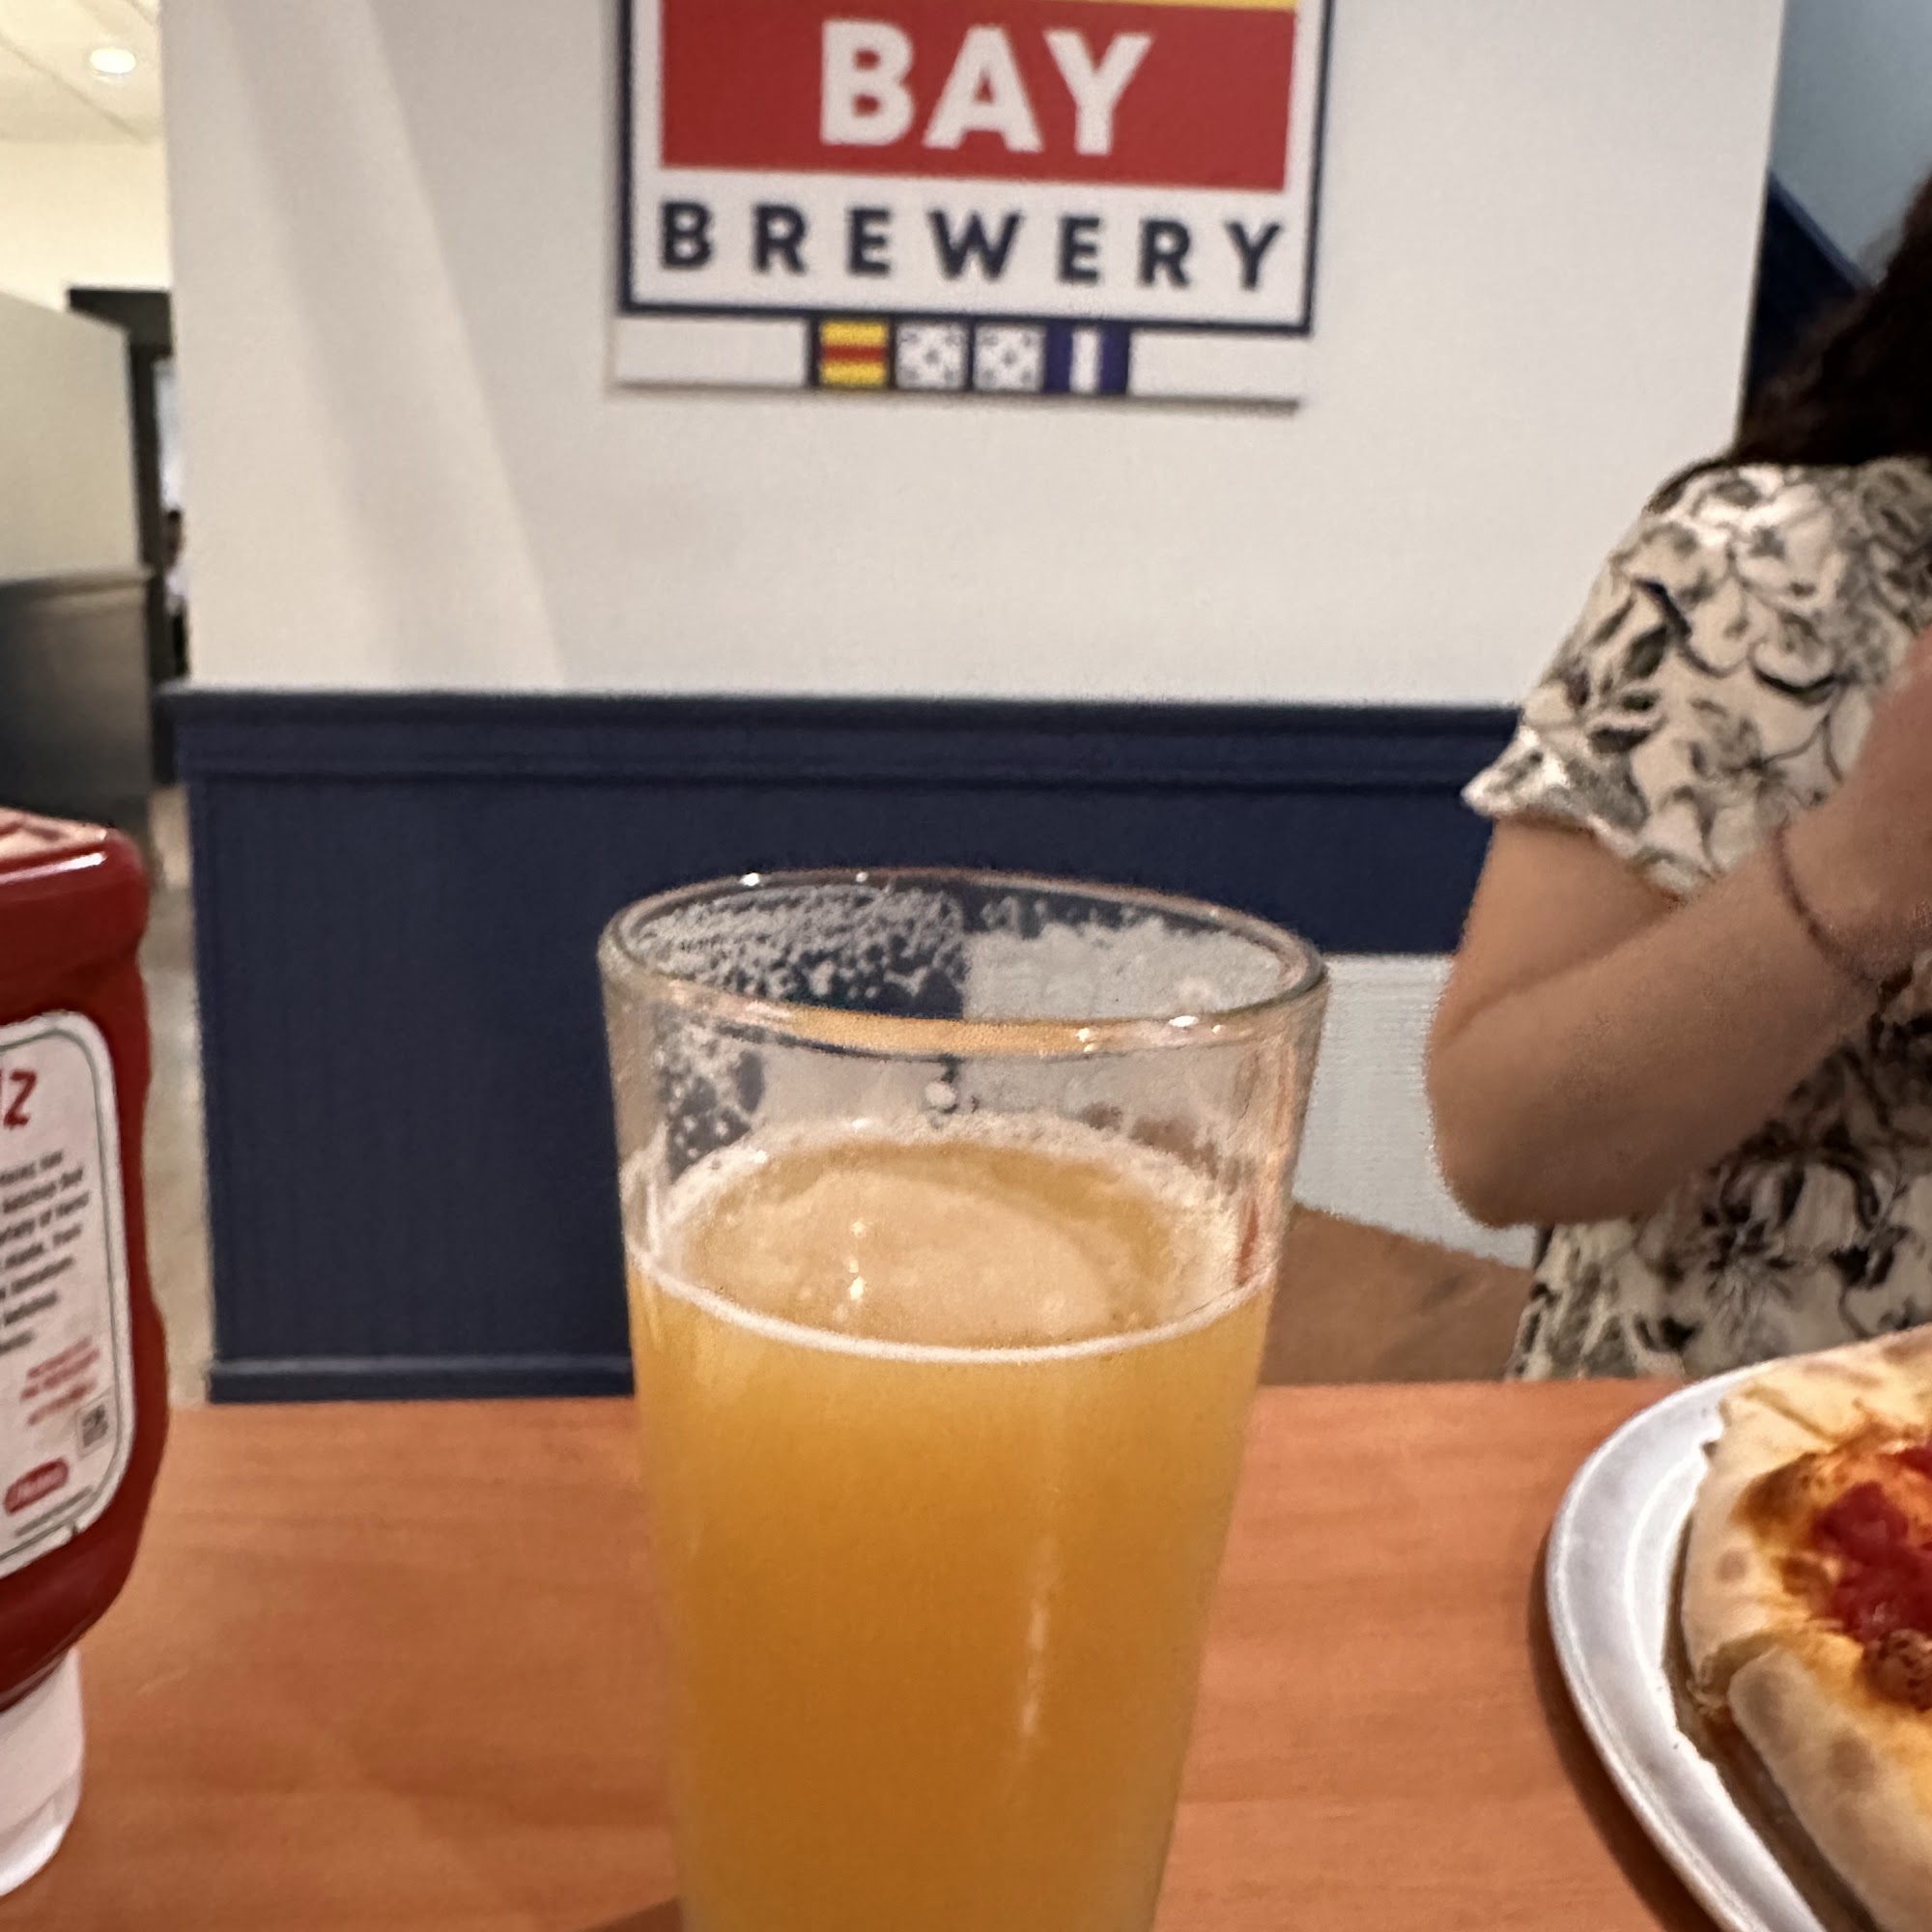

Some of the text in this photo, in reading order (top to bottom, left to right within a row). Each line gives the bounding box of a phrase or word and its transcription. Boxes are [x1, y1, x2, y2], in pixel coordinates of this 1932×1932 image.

[819, 18, 1152, 156] BAY
[660, 201, 1284, 291] BREWERY
[0, 1068, 37, 1128] Z
